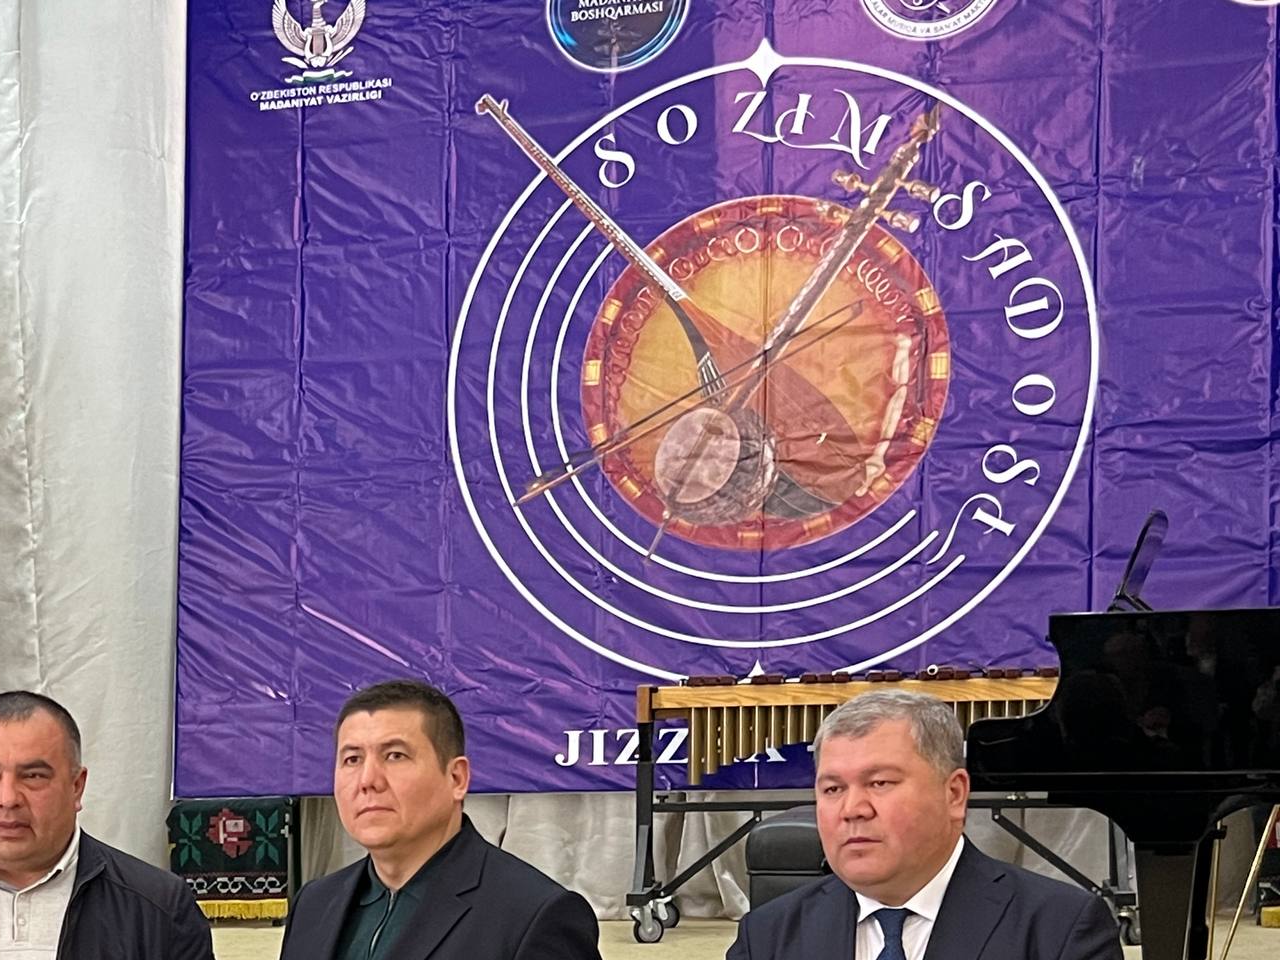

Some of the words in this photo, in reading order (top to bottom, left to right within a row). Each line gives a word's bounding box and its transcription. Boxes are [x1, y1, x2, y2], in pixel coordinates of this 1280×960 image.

[570, 1, 664, 22] BOSHQARMASI
[318, 77, 393, 95] RESPUBLIKASI
[259, 95, 325, 112] MADANIYAT
[326, 89, 382, 105] VAZIRLIGI
